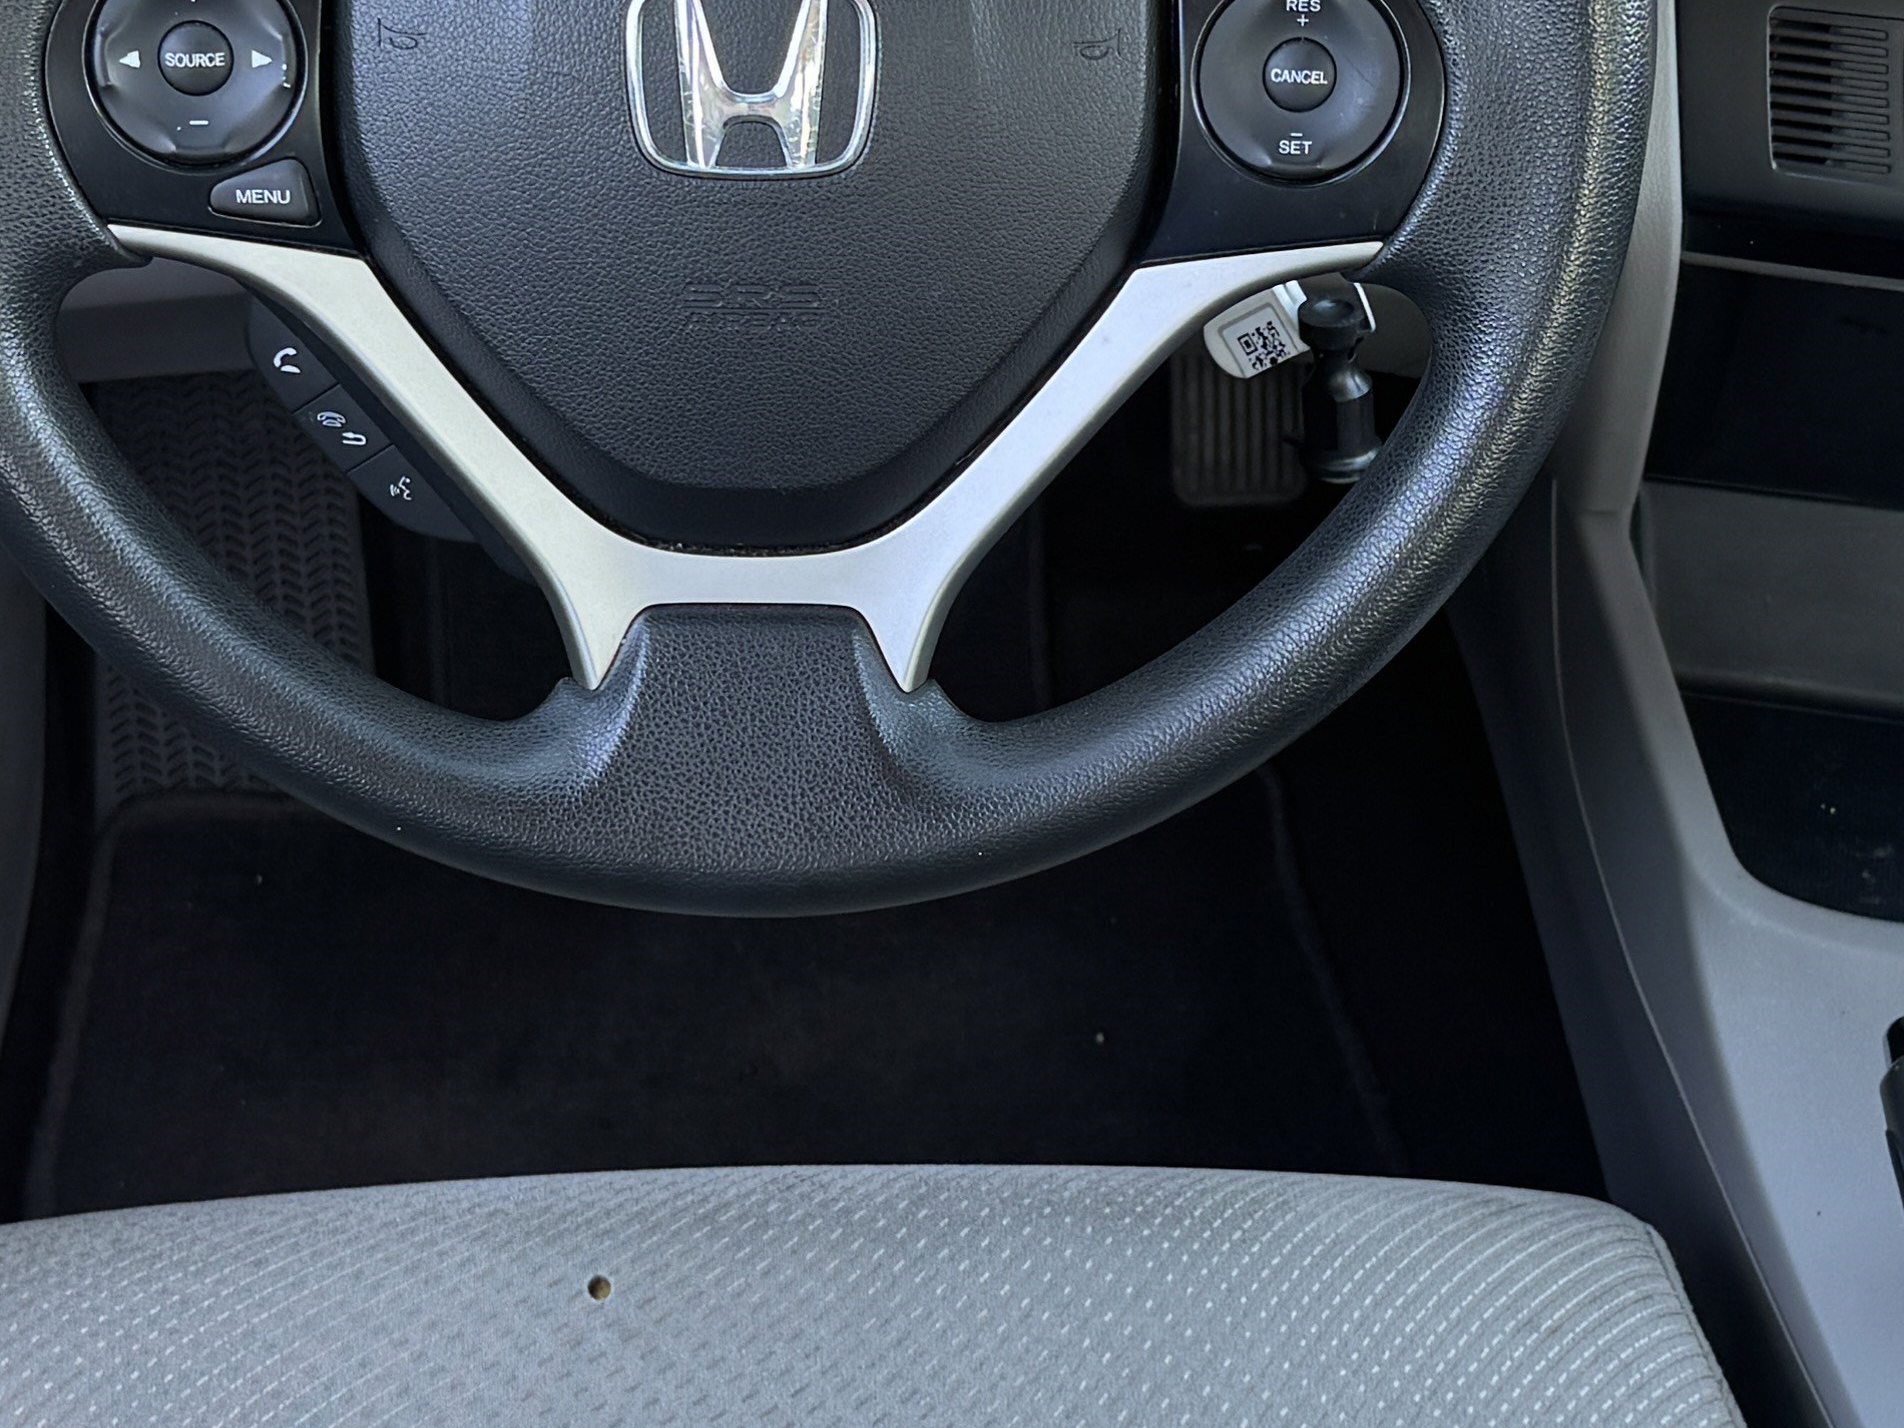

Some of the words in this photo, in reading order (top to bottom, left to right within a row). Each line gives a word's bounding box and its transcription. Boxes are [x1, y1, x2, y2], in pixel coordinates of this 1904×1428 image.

[164, 52, 226, 68] SOURCE
[1269, 68, 1328, 86] CANCEL
[1278, 139, 1313, 155] SET
[235, 188, 292, 205] MENU
